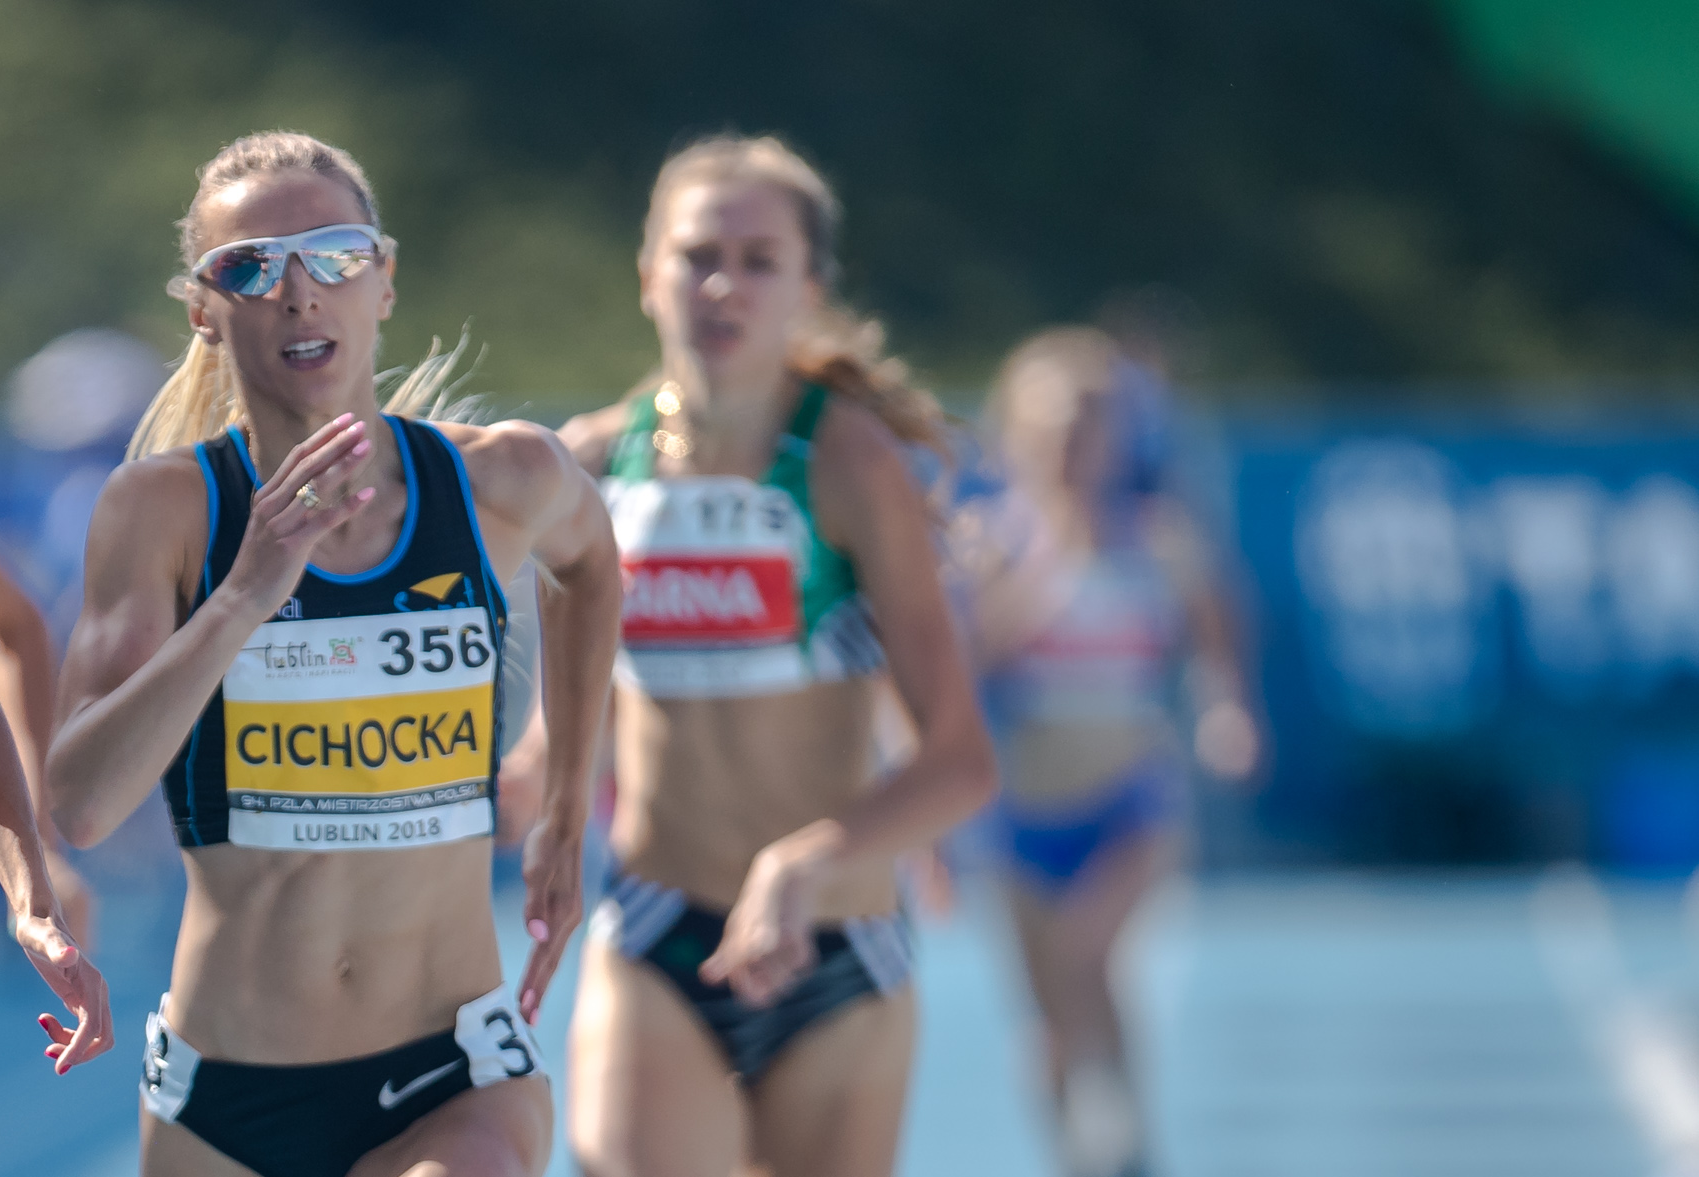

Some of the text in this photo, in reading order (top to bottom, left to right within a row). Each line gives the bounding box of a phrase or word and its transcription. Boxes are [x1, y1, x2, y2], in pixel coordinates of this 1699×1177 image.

[621, 565, 770, 624] ARNA
[378, 622, 491, 677] 356
[236, 707, 478, 770] CICHOCKA
[269, 796, 314, 811] PZLA
[316, 792, 435, 811] MISTRZOSTWA
[434, 783, 478, 802] POLSKI
[292, 816, 441, 843] LUBLIN 2018
[482, 1006, 534, 1077] 3
